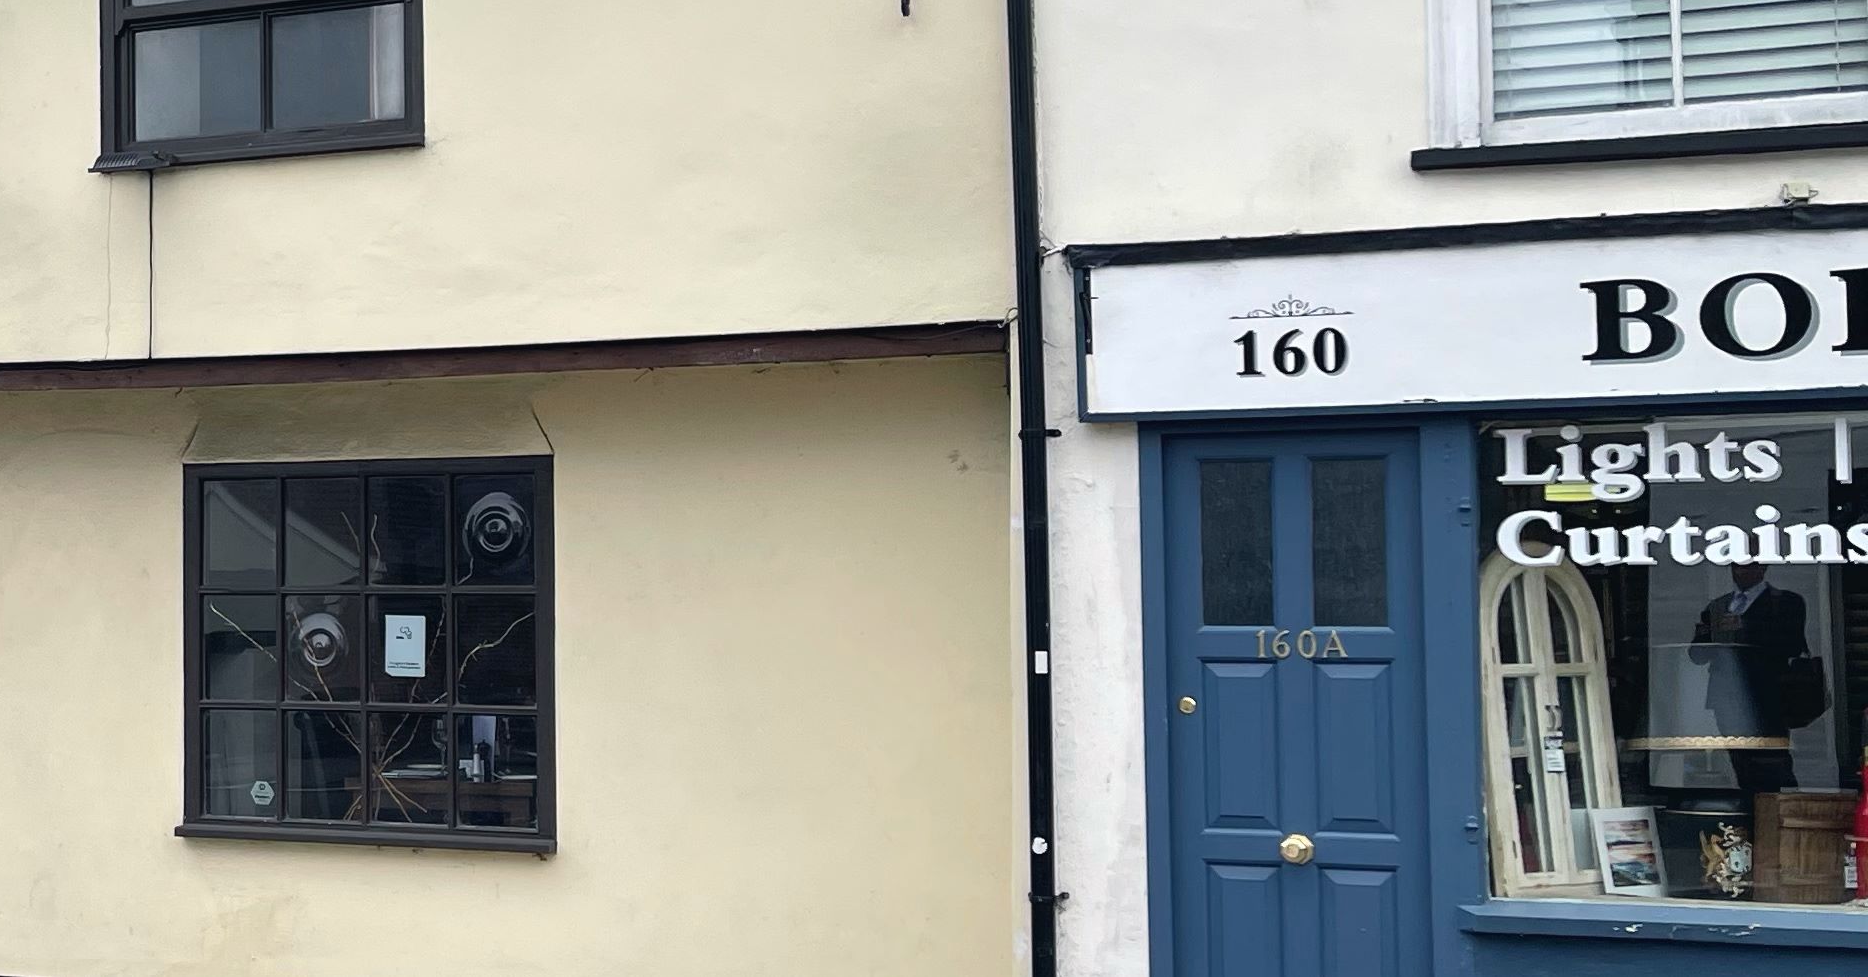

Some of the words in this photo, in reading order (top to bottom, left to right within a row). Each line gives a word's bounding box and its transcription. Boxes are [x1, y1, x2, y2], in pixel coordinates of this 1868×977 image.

[1233, 327, 1349, 378] 160
[1493, 421, 1783, 503] Lights
[1255, 629, 1349, 659] 160A
